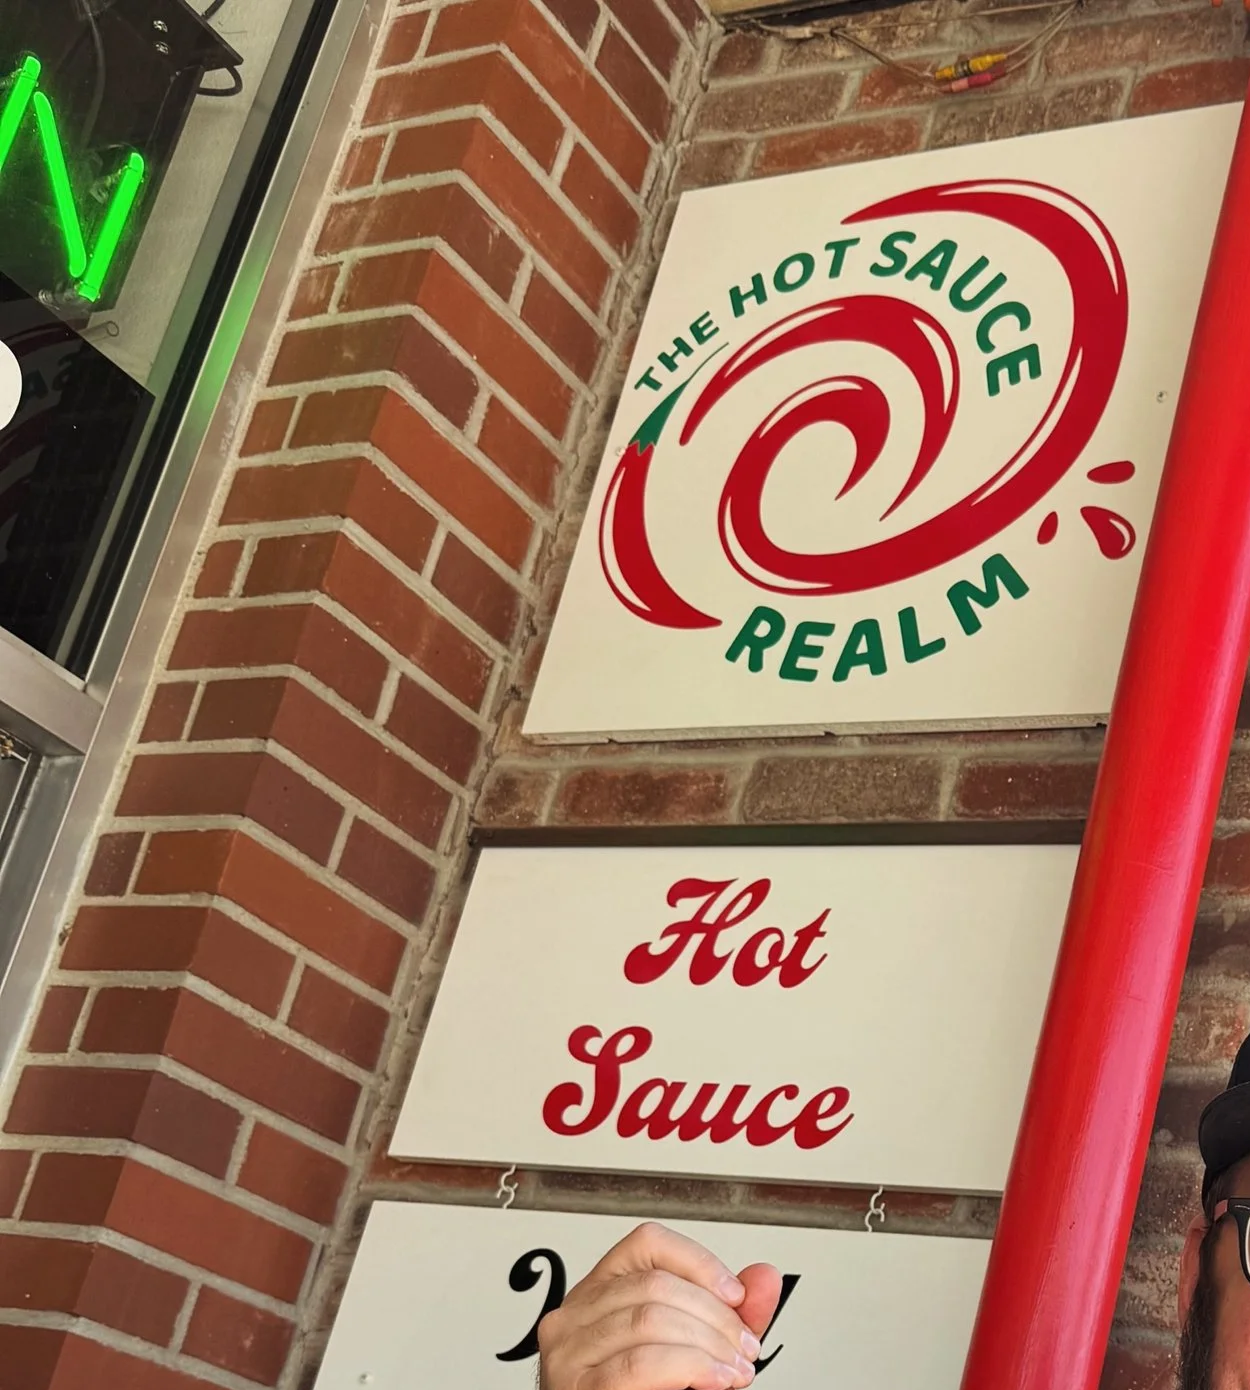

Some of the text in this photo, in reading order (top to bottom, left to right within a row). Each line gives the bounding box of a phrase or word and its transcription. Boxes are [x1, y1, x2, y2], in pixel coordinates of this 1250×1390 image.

[633, 230, 1042, 398] THE HOT SAUCE
[723, 553, 1031, 685] REALM
[623, 877, 832, 989] Hot
[541, 1024, 855, 1151] Sauce
